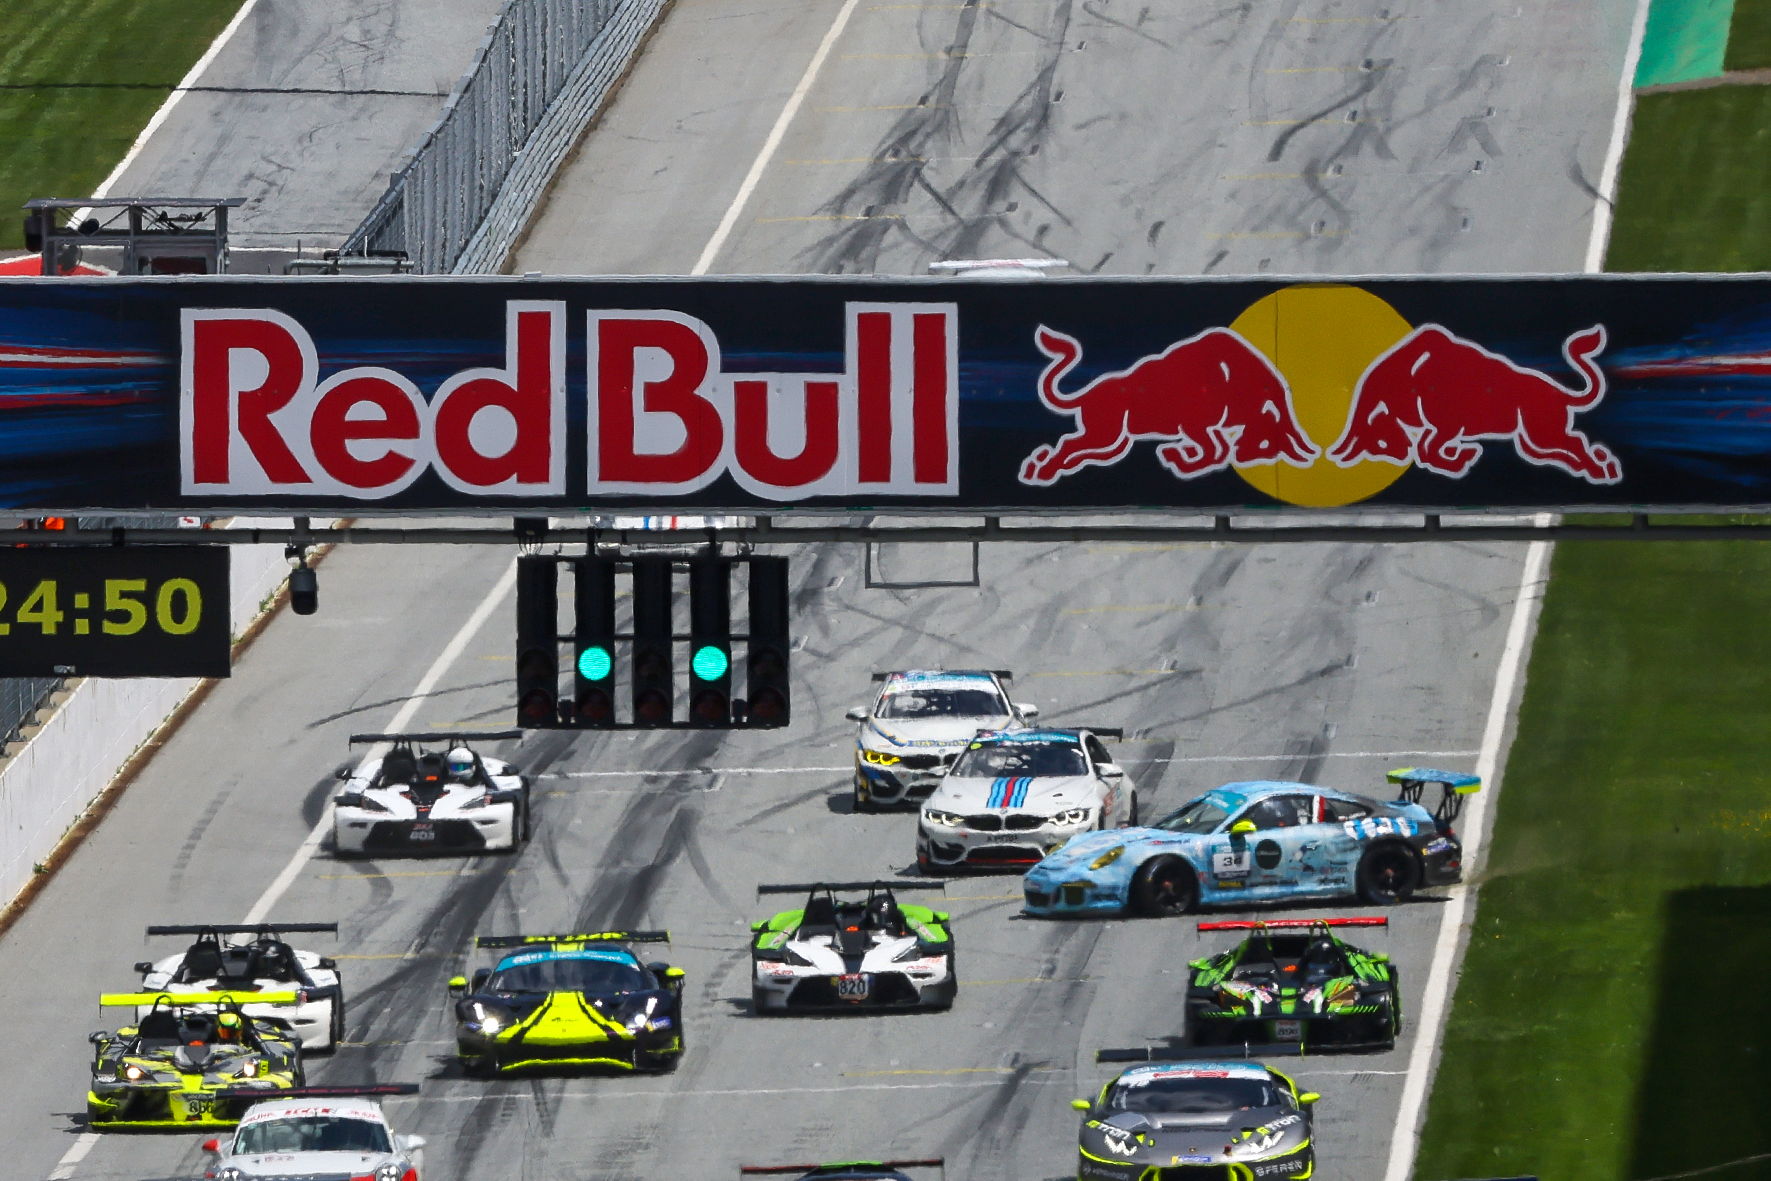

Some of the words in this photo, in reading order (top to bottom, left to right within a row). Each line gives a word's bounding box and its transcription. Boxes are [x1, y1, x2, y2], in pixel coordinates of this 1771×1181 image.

[181, 301, 566, 499] Red
[586, 301, 960, 501] Bull
[839, 980, 867, 995] 820
